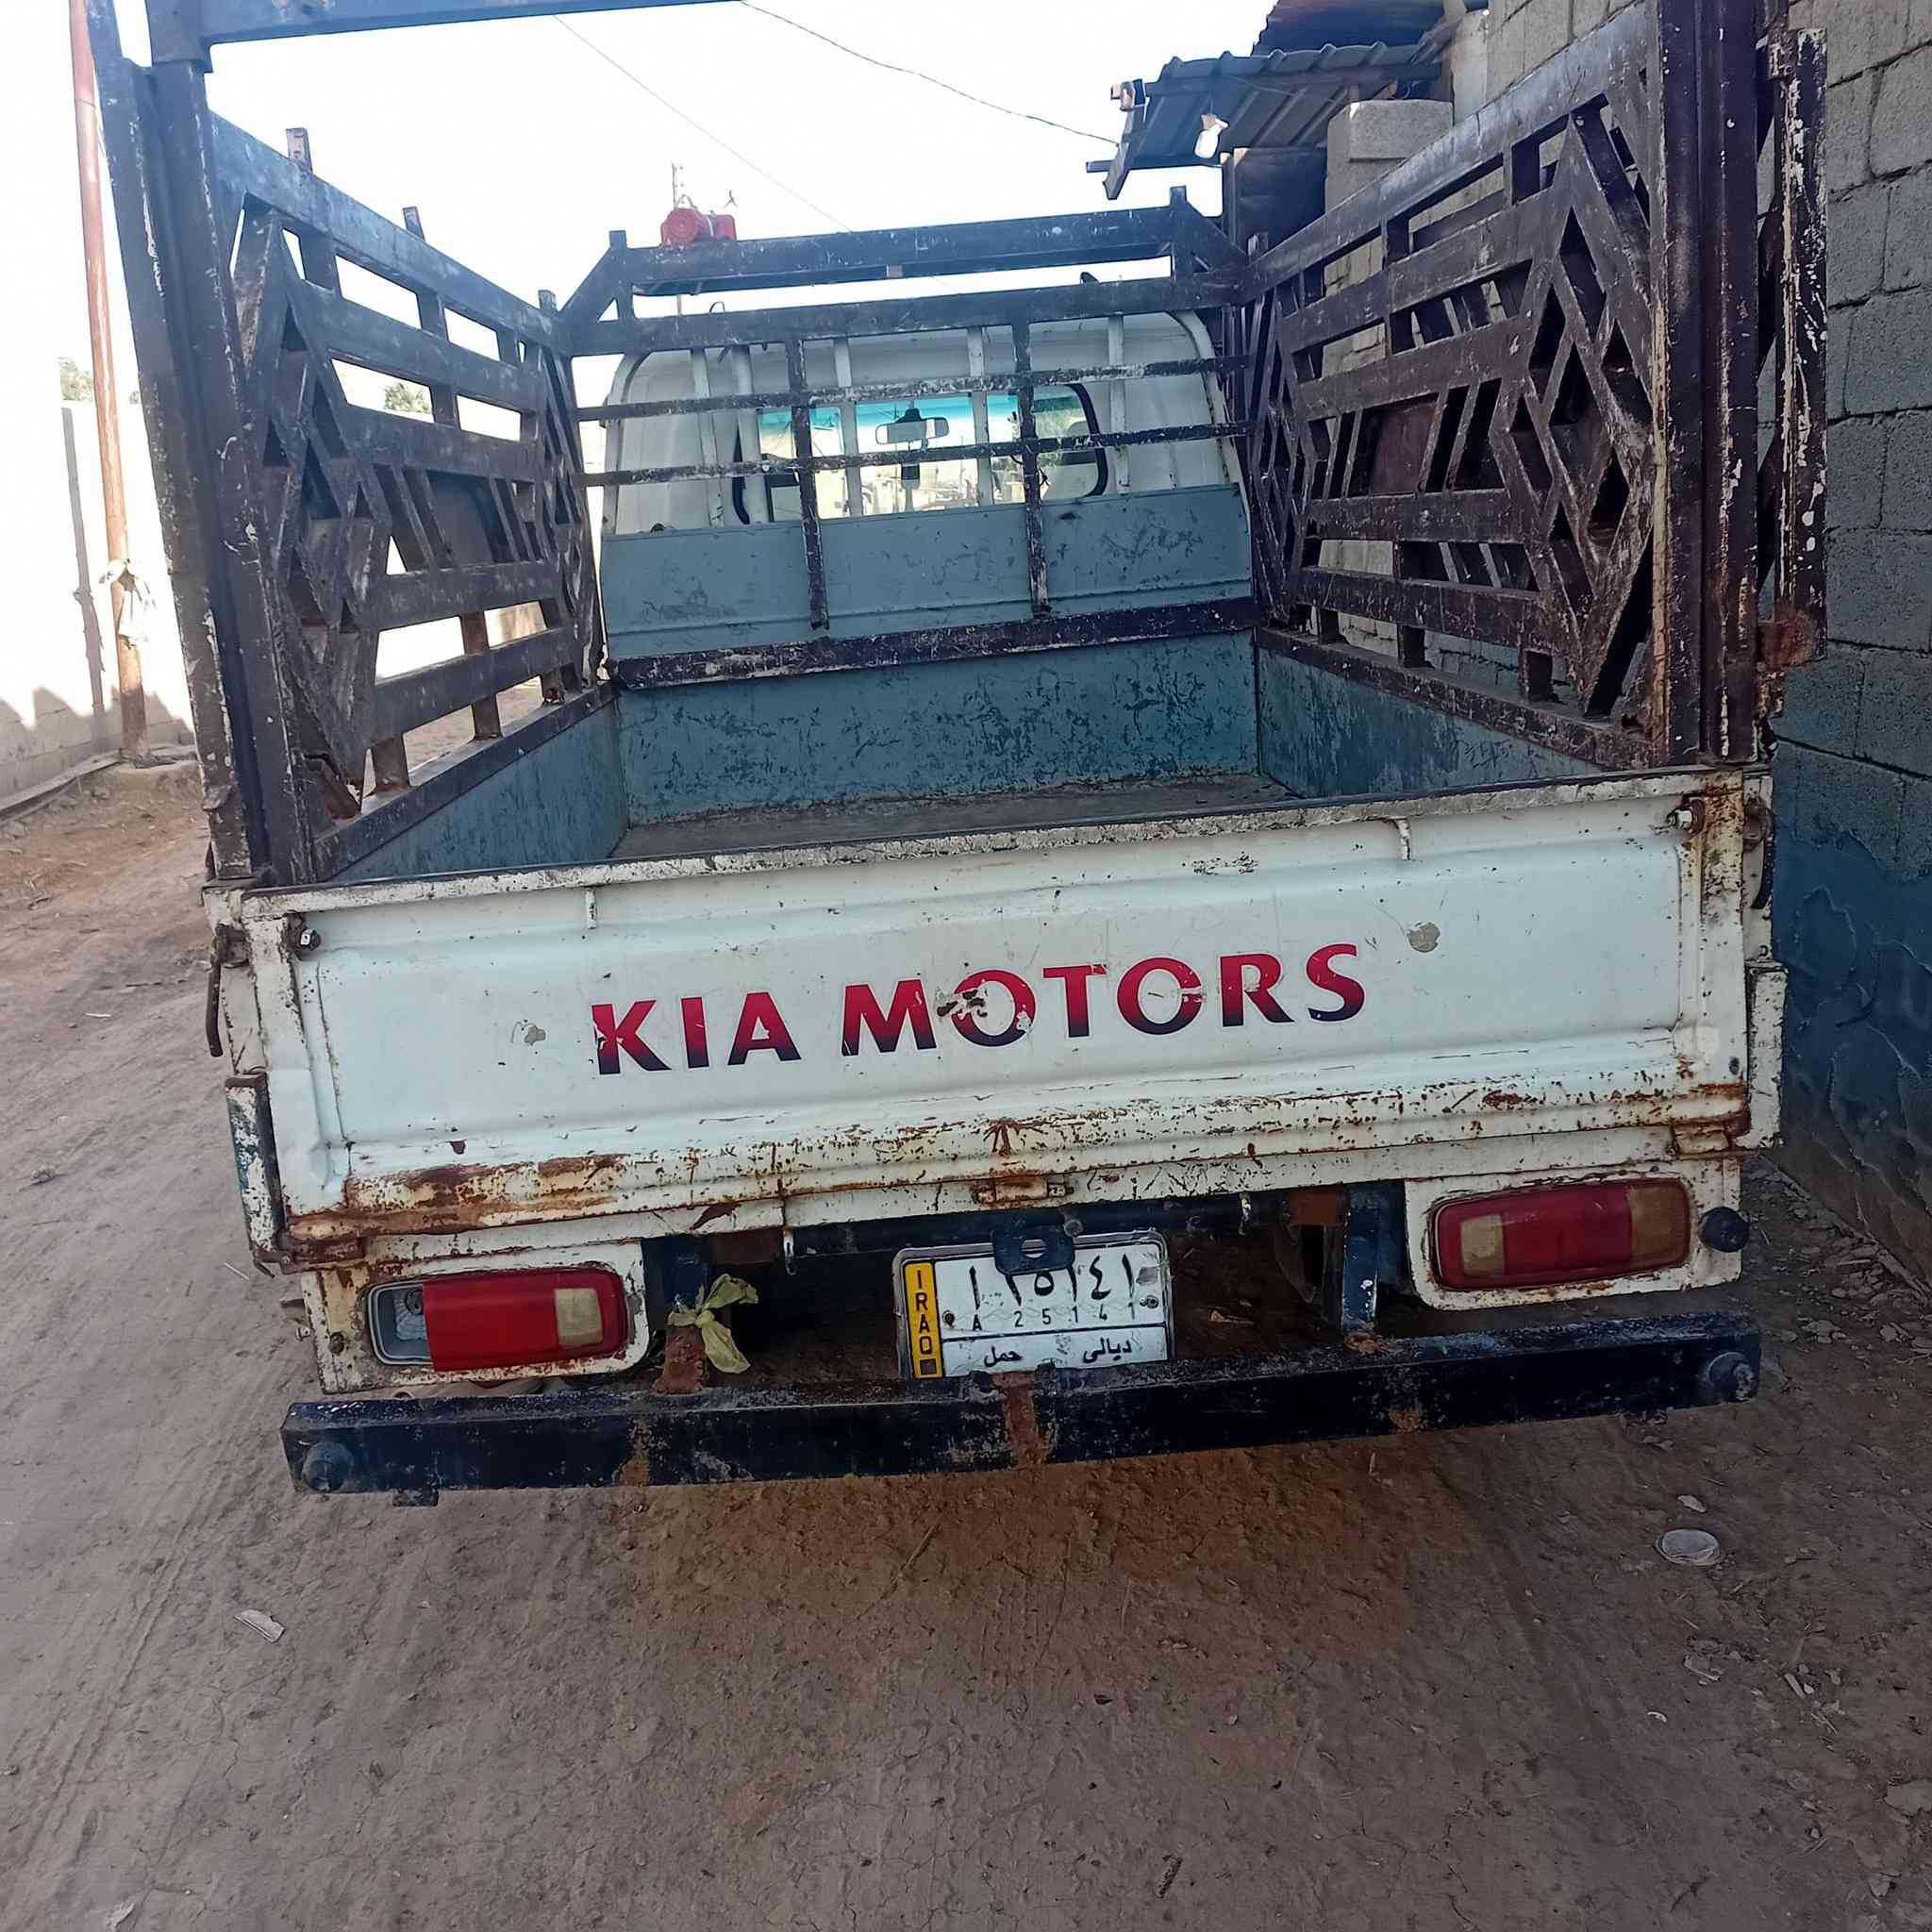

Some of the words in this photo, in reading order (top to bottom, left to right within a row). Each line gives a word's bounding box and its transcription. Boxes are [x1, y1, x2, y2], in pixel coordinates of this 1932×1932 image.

[591, 991, 803, 1075] KIA
[841, 943, 1367, 1058] MOTORS
[915, 1269, 934, 1356] IRAQ
[972, 1313, 983, 1331] A
[983, 1346, 1023, 1368] حمل
